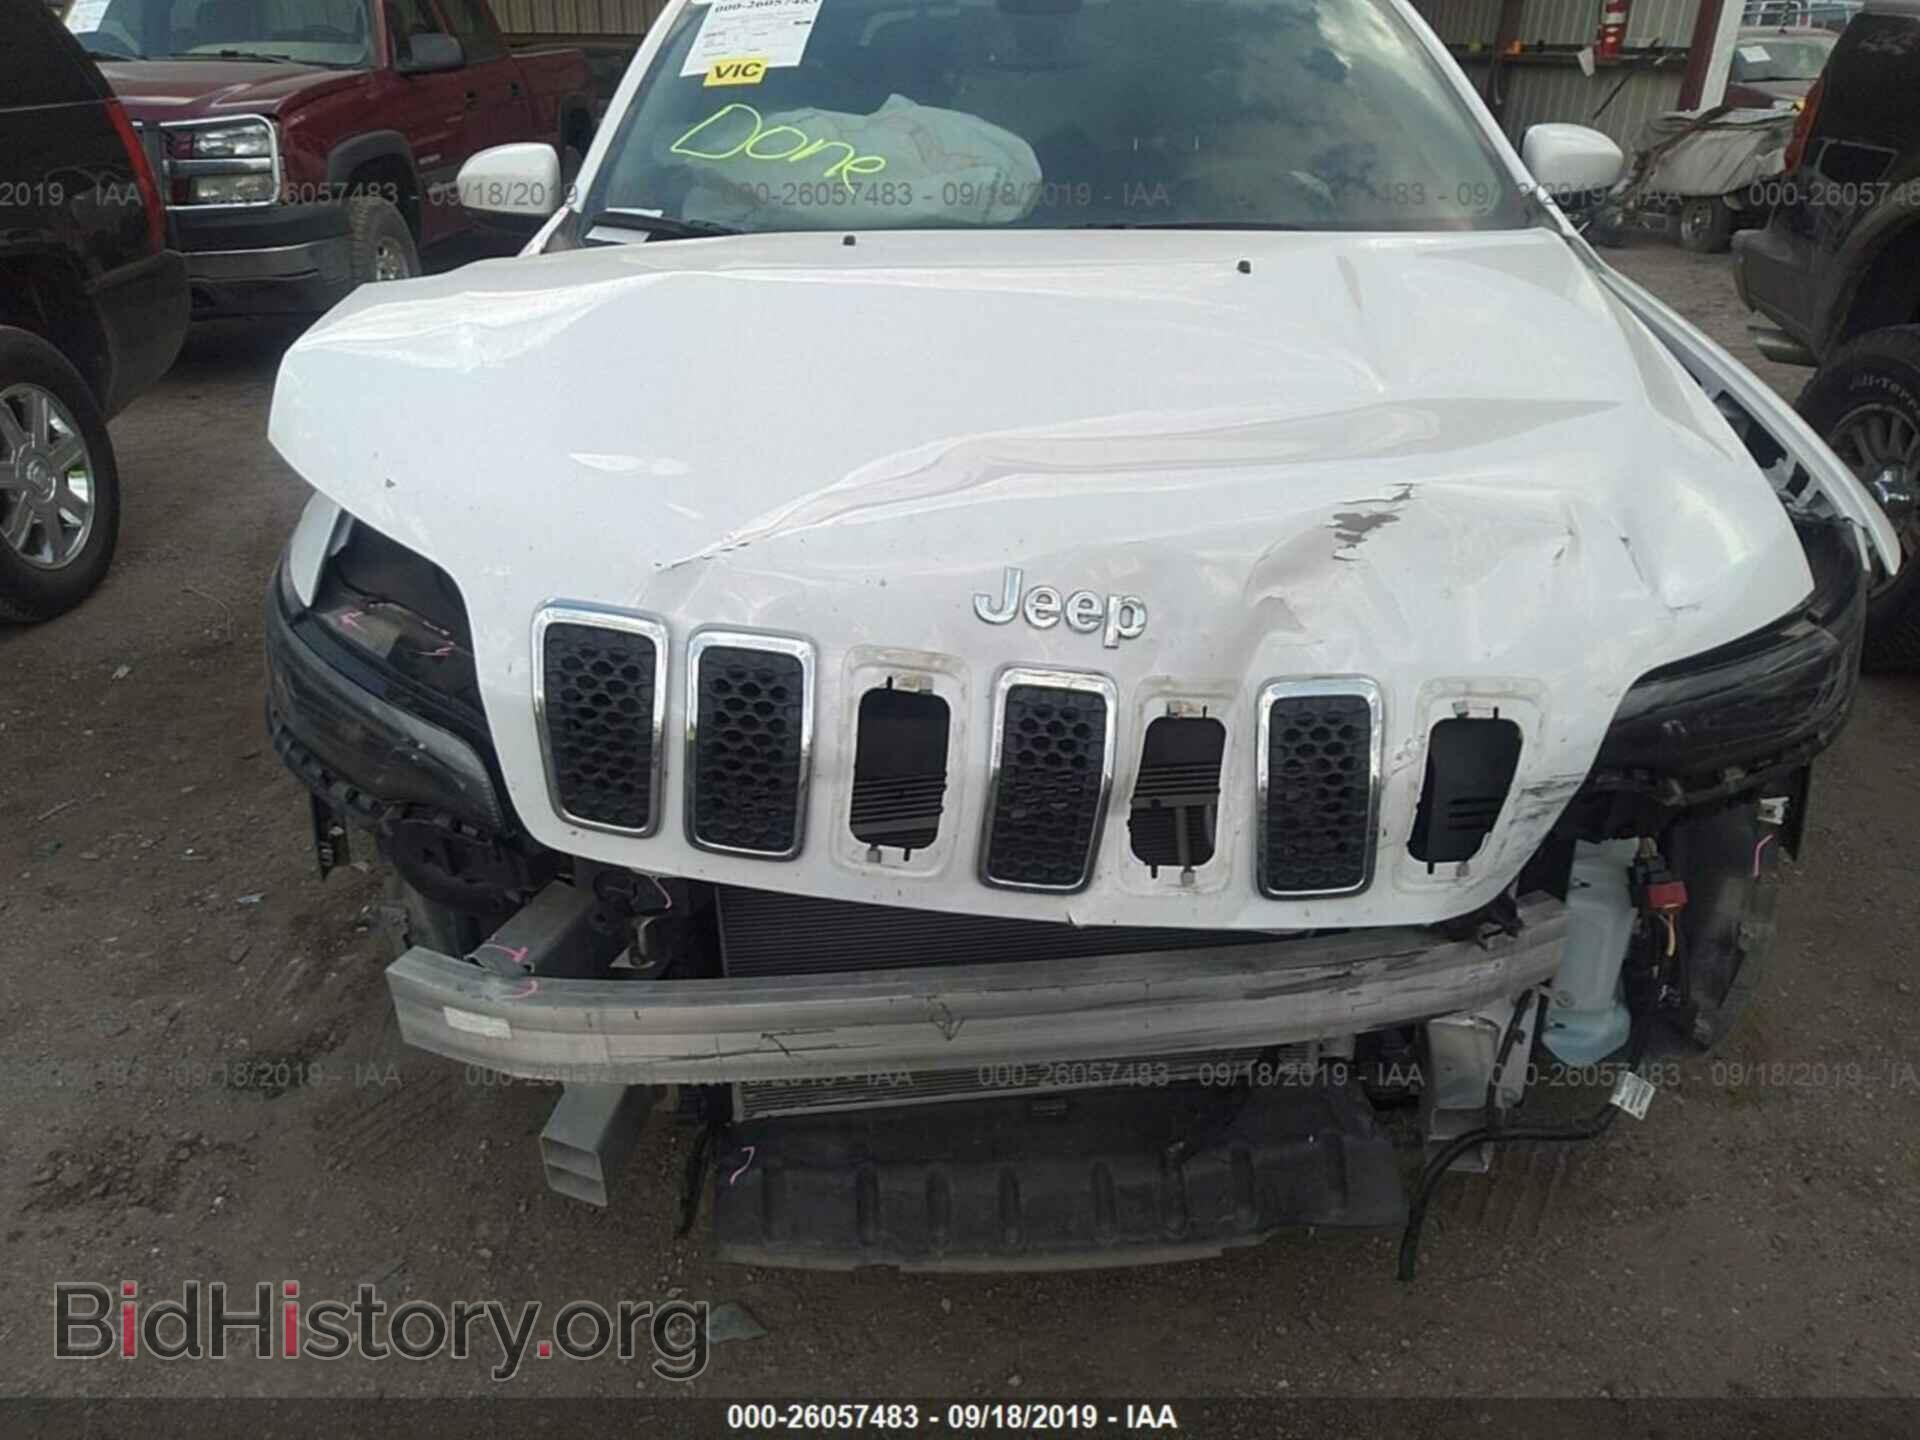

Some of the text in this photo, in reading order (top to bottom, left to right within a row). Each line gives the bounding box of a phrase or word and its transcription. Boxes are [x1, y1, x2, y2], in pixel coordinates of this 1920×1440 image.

[714, 62, 762, 79] VIC
[670, 103, 886, 194] Done
[973, 566, 1147, 649] Jeep
